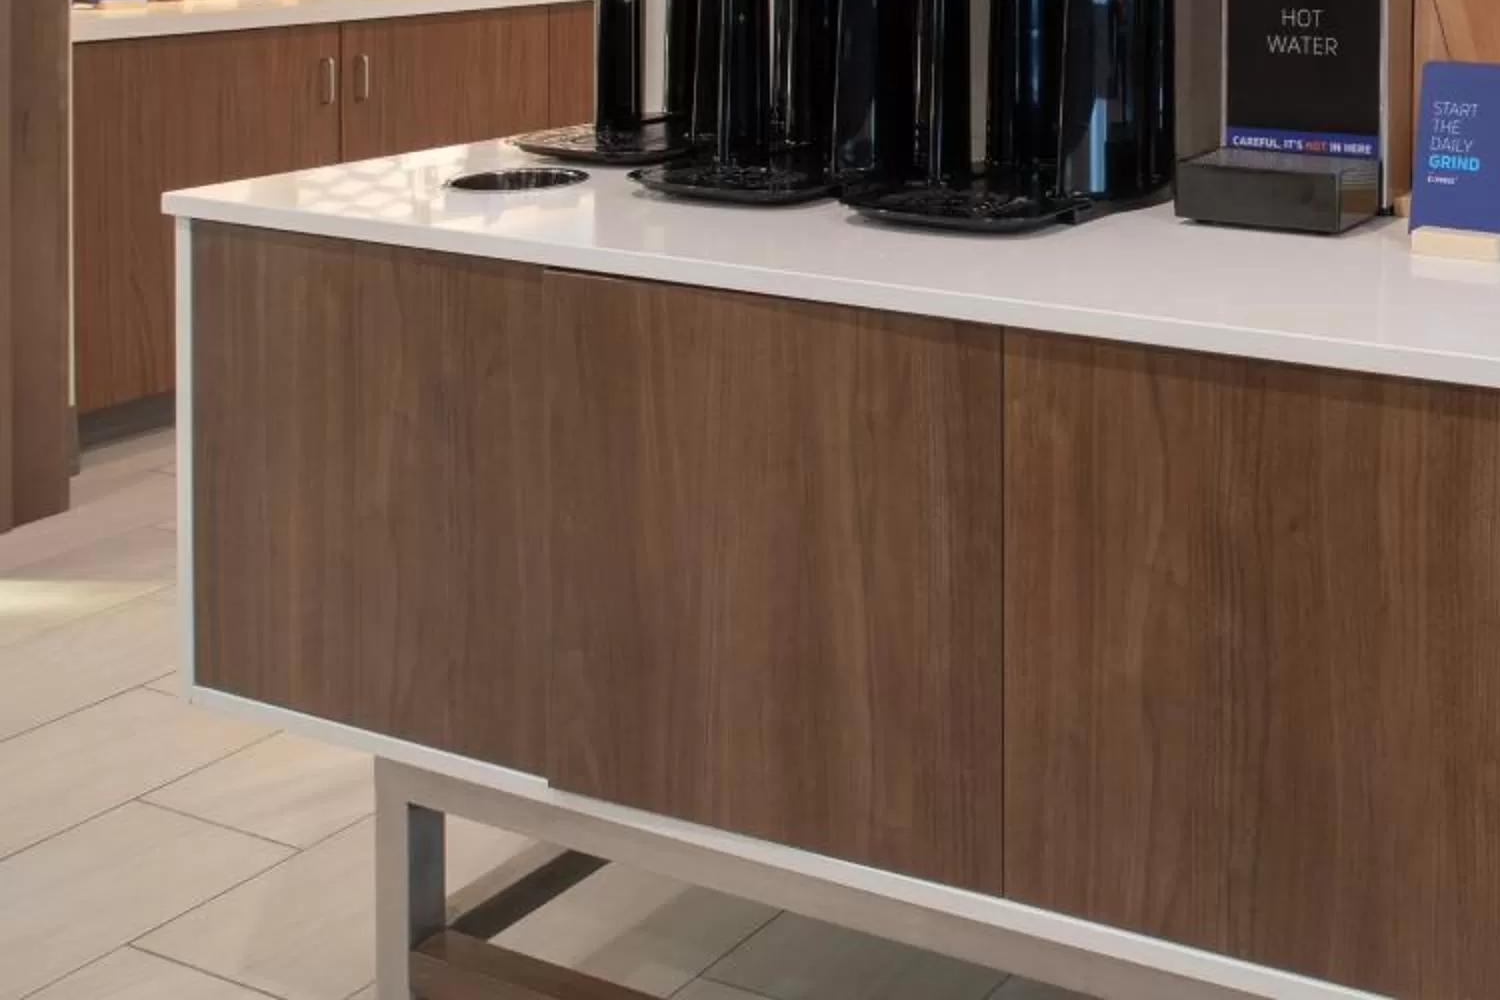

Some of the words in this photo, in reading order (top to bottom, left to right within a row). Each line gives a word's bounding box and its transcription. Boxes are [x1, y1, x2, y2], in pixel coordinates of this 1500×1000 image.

[1281, 8, 1324, 28] HOT
[1267, 35, 1339, 56] WATER
[1433, 101, 1478, 117] START
[1433, 119, 1461, 135] THE
[1283, 139, 1303, 151] IT'S
[1305, 140, 1327, 152] HOT
[1329, 141, 1341, 153] IN
[1343, 142, 1373, 155] HERE
[1430, 136, 1473, 153] DAILY
[1428, 155, 1480, 172] GRIND
